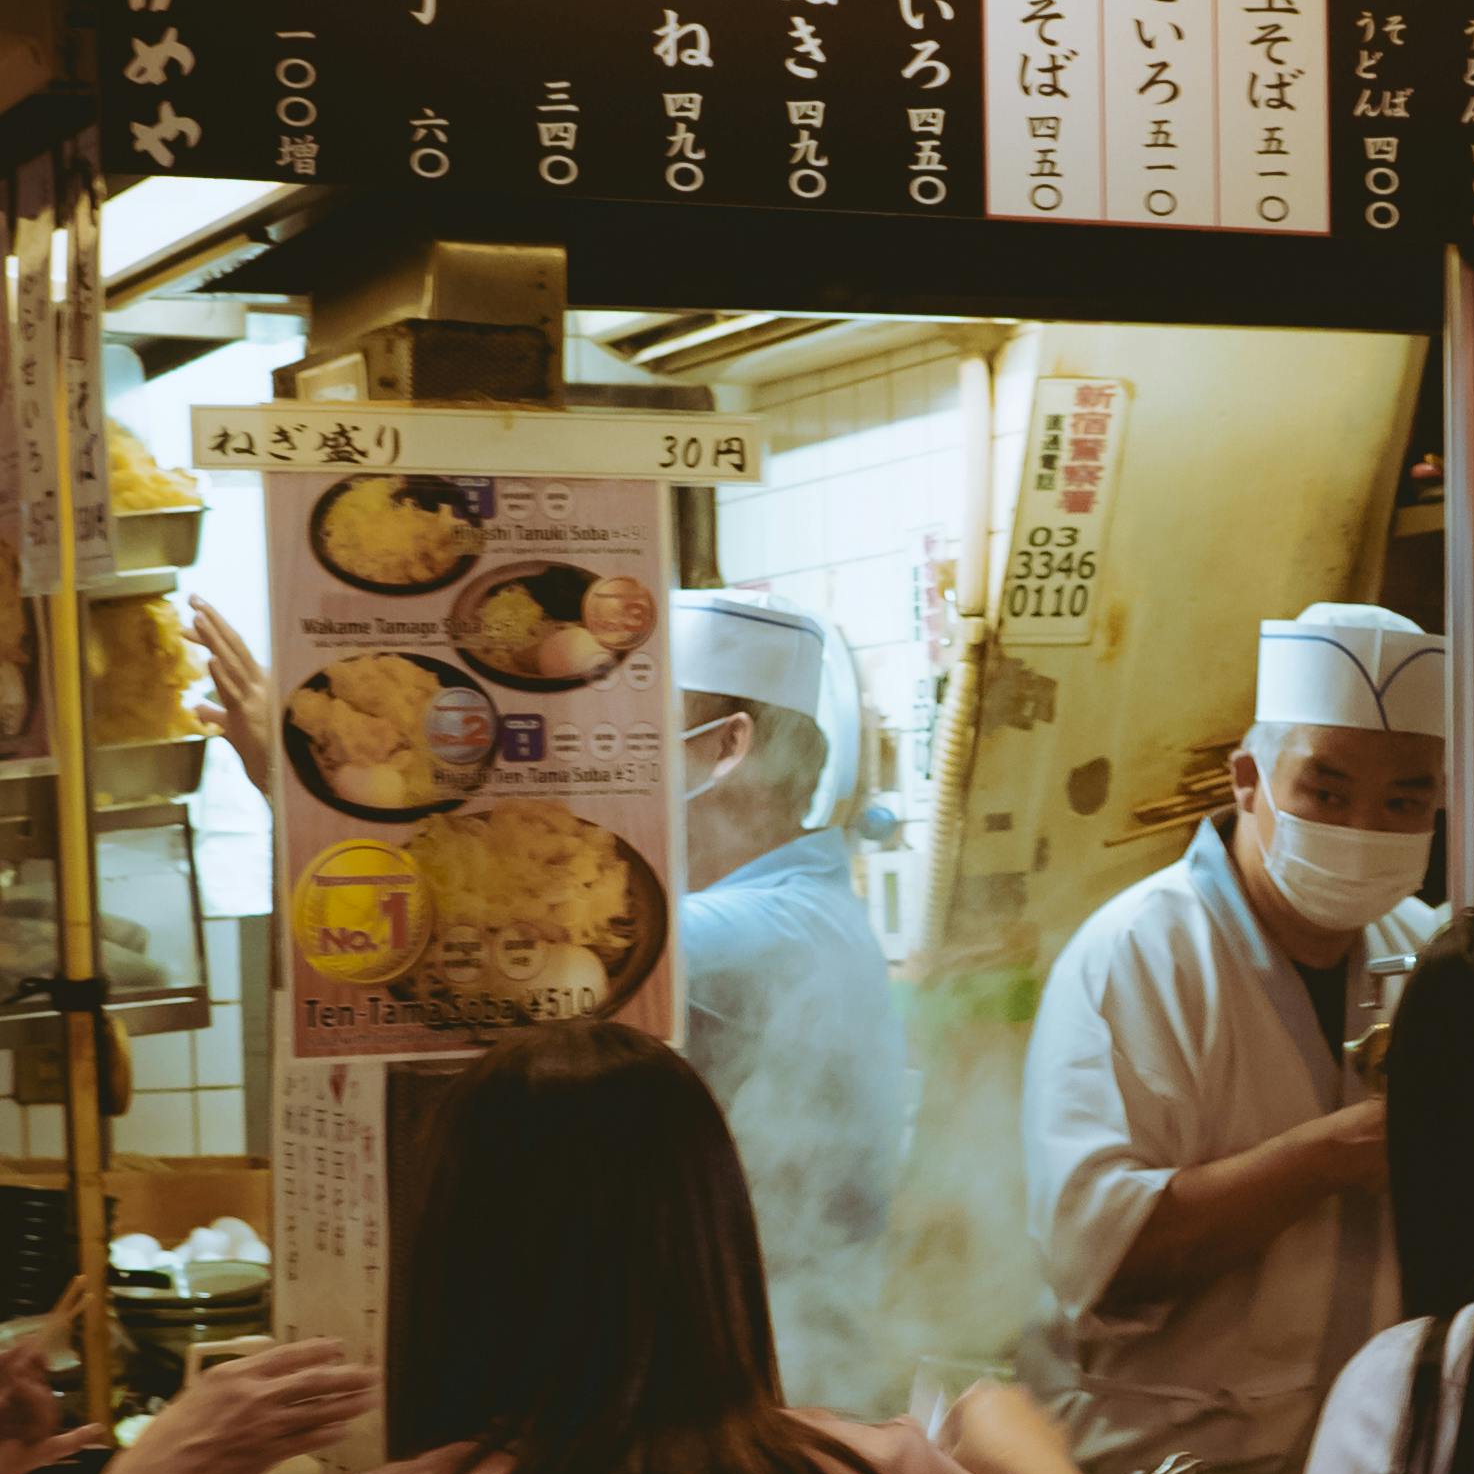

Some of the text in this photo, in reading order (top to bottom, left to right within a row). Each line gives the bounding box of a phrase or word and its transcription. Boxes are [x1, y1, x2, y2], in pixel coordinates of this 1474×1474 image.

[208, 422, 401, 466] ねぎ盛り
[1029, 527, 1079, 547] 03
[1015, 551, 1095, 580] 3346
[1009, 584, 1088, 617] 0110
